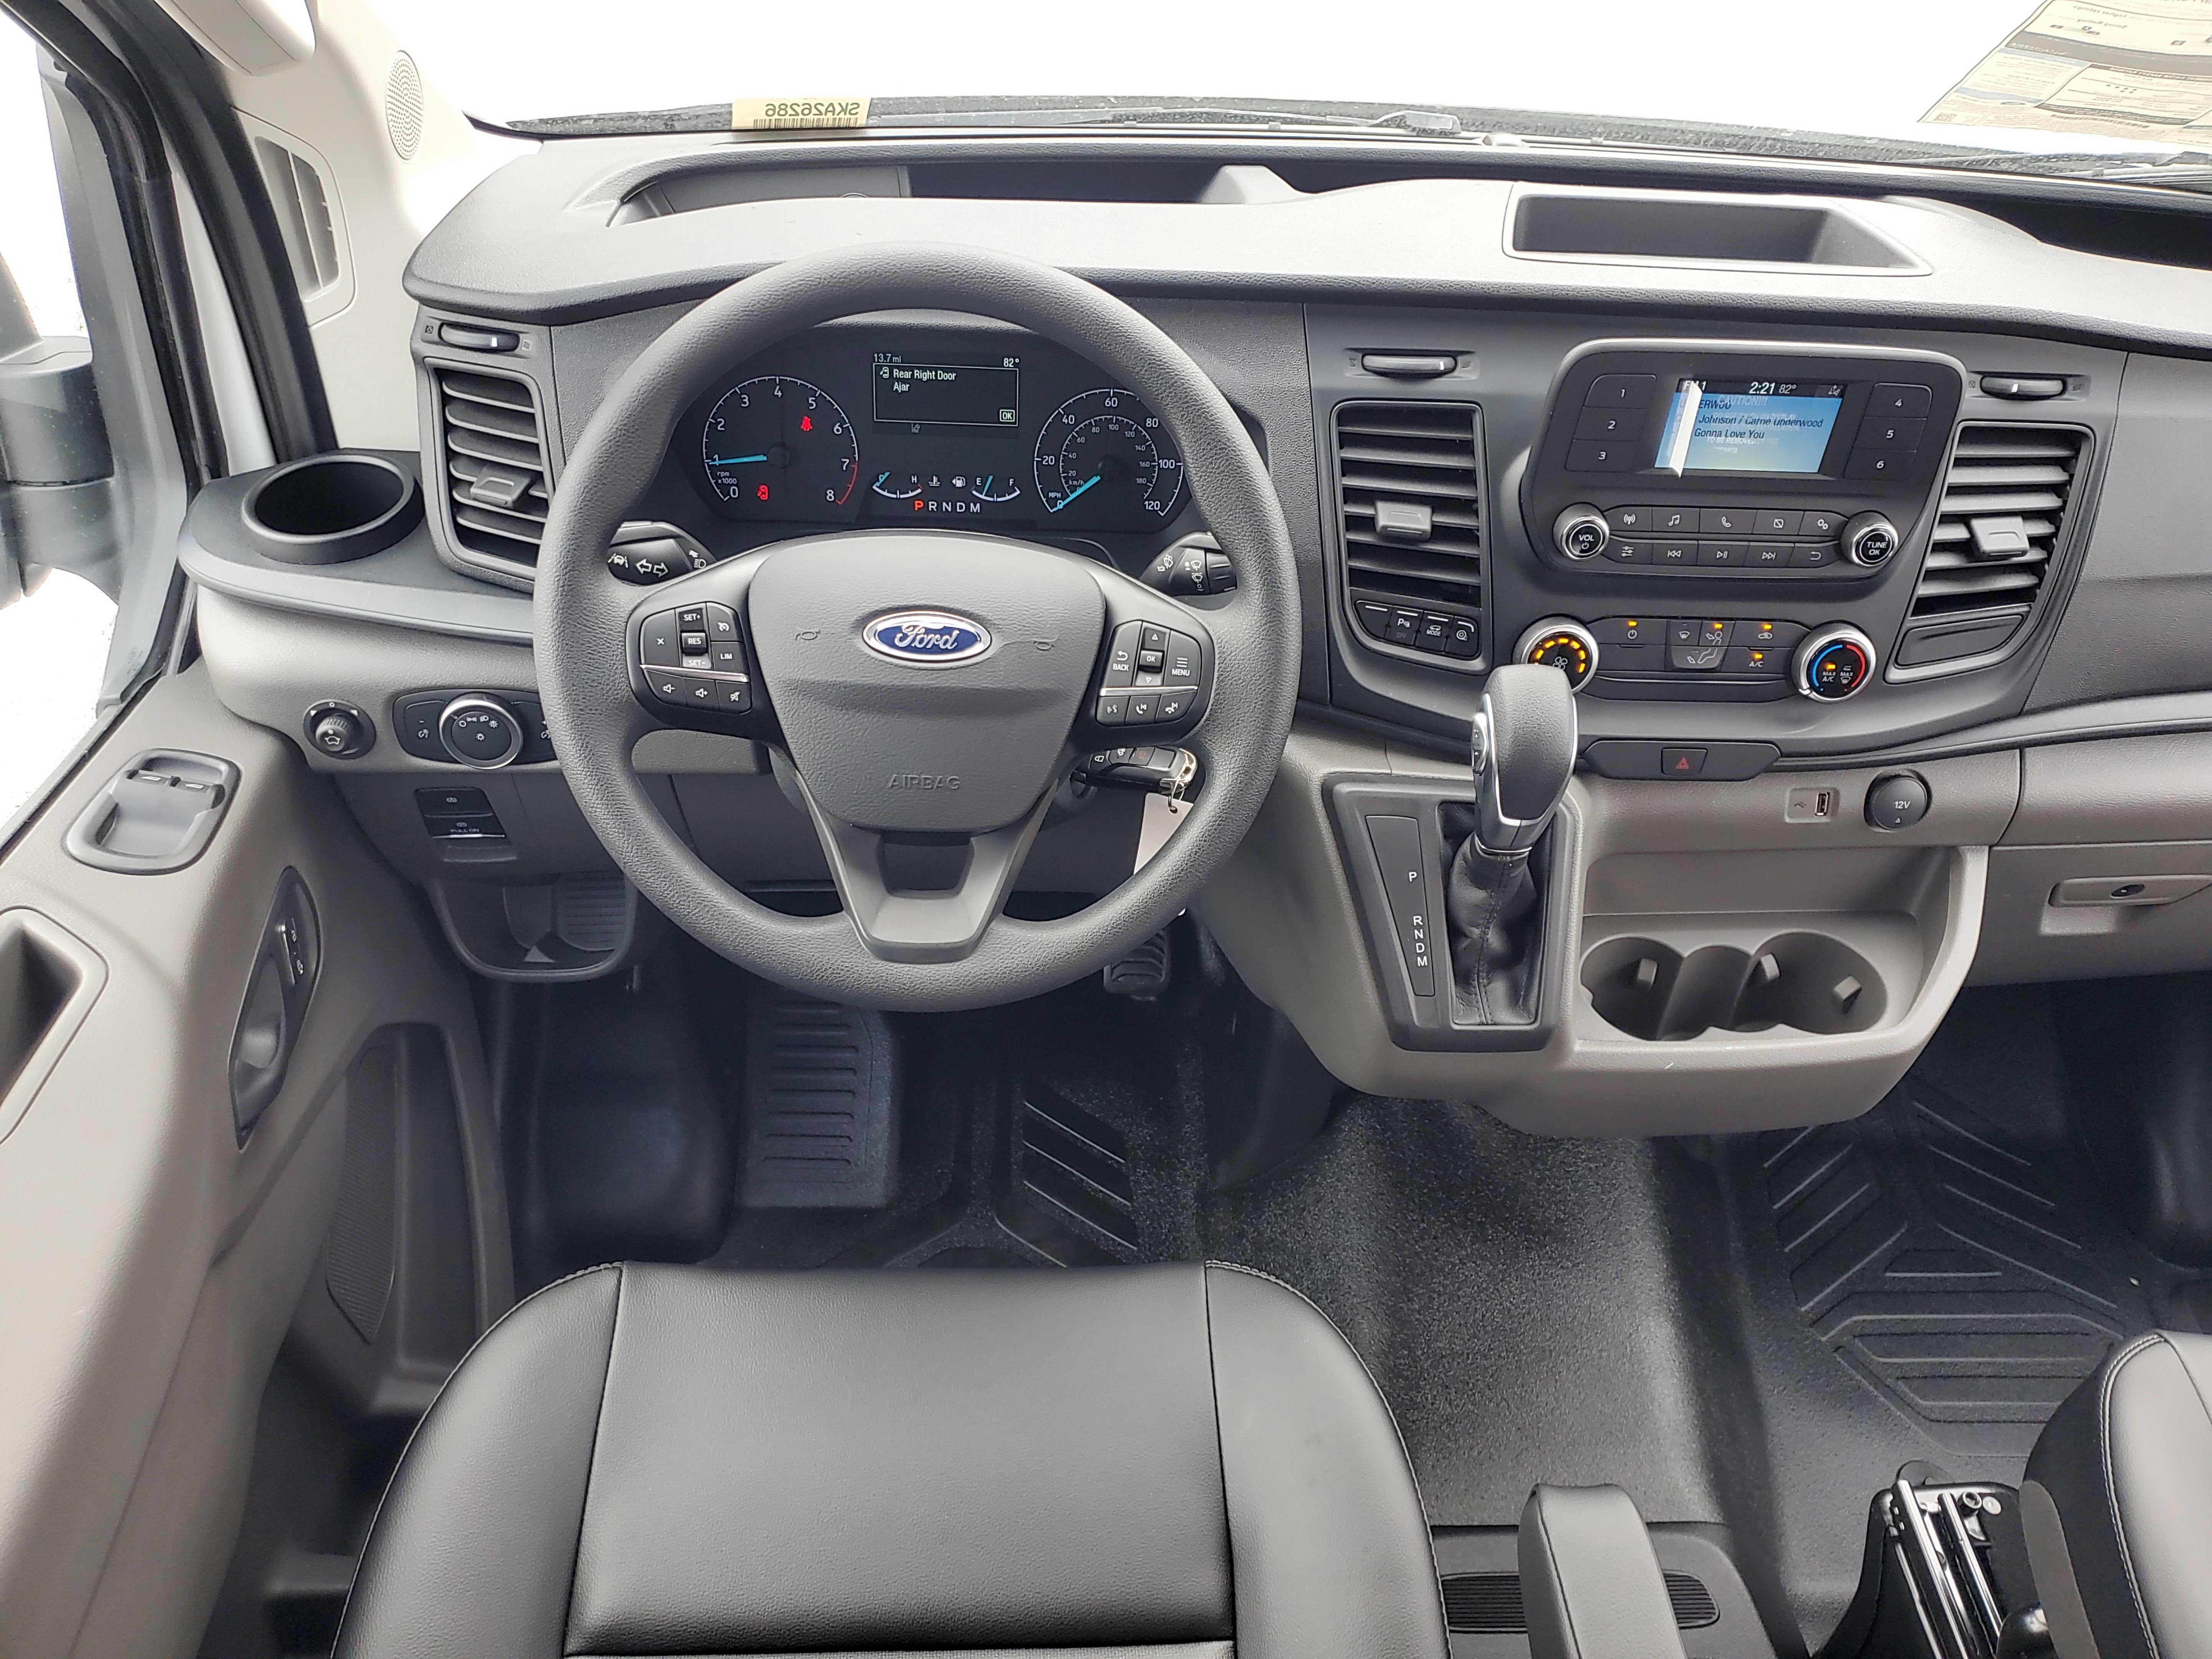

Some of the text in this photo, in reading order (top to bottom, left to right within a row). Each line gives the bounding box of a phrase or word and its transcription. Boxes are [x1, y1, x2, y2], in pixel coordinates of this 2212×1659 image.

[874, 353, 892, 362] 13.7
[893, 369, 956, 381] Rear Right Door
[774, 386, 782, 397] 4
[893, 381, 910, 393] Ajar
[1748, 382, 1776, 394] 2:21
[1620, 389, 1626, 398] 1
[741, 395, 749, 407] 3
[808, 397, 816, 409] 5
[1104, 397, 1118, 407] 60
[1894, 398, 1902, 407] 4
[1002, 412, 1013, 420] OK
[1062, 415, 1075, 424] 40
[1699, 414, 1737, 424] Johnson
[717, 419, 725, 430] 2
[1146, 417, 1159, 427] 80
[1608, 421, 1616, 429] 2
[833, 423, 842, 435] 6
[1695, 428, 1722, 438] Gonna
[1725, 429, 1746, 439] Love
[1748, 430, 1765, 439] You
[1886, 430, 1894, 439] 5
[1043, 455, 1055, 465] 20
[1598, 452, 1606, 460] 3
[840, 459, 849, 471] 7
[1158, 459, 1175, 469] 100
[1876, 460, 1885, 469] 6
[911, 475, 917, 483] H
[976, 477, 982, 485] E
[1009, 478, 1014, 487] F
[730, 486, 738, 498] 0
[826, 489, 835, 502] 8
[914, 500, 980, 513] P R N D M
[1144, 501, 1160, 510] 120
[1113, 663, 1129, 671] BACK
[1171, 668, 1190, 676] MENU
[889, 774, 960, 789] AIRBAG
[1894, 801, 1911, 809] 12V
[1408, 872, 1417, 882] P
[1413, 916, 1423, 926] R
[1414, 929, 1424, 939] N
[1416, 943, 1425, 953] D
[1417, 955, 1428, 967] M
